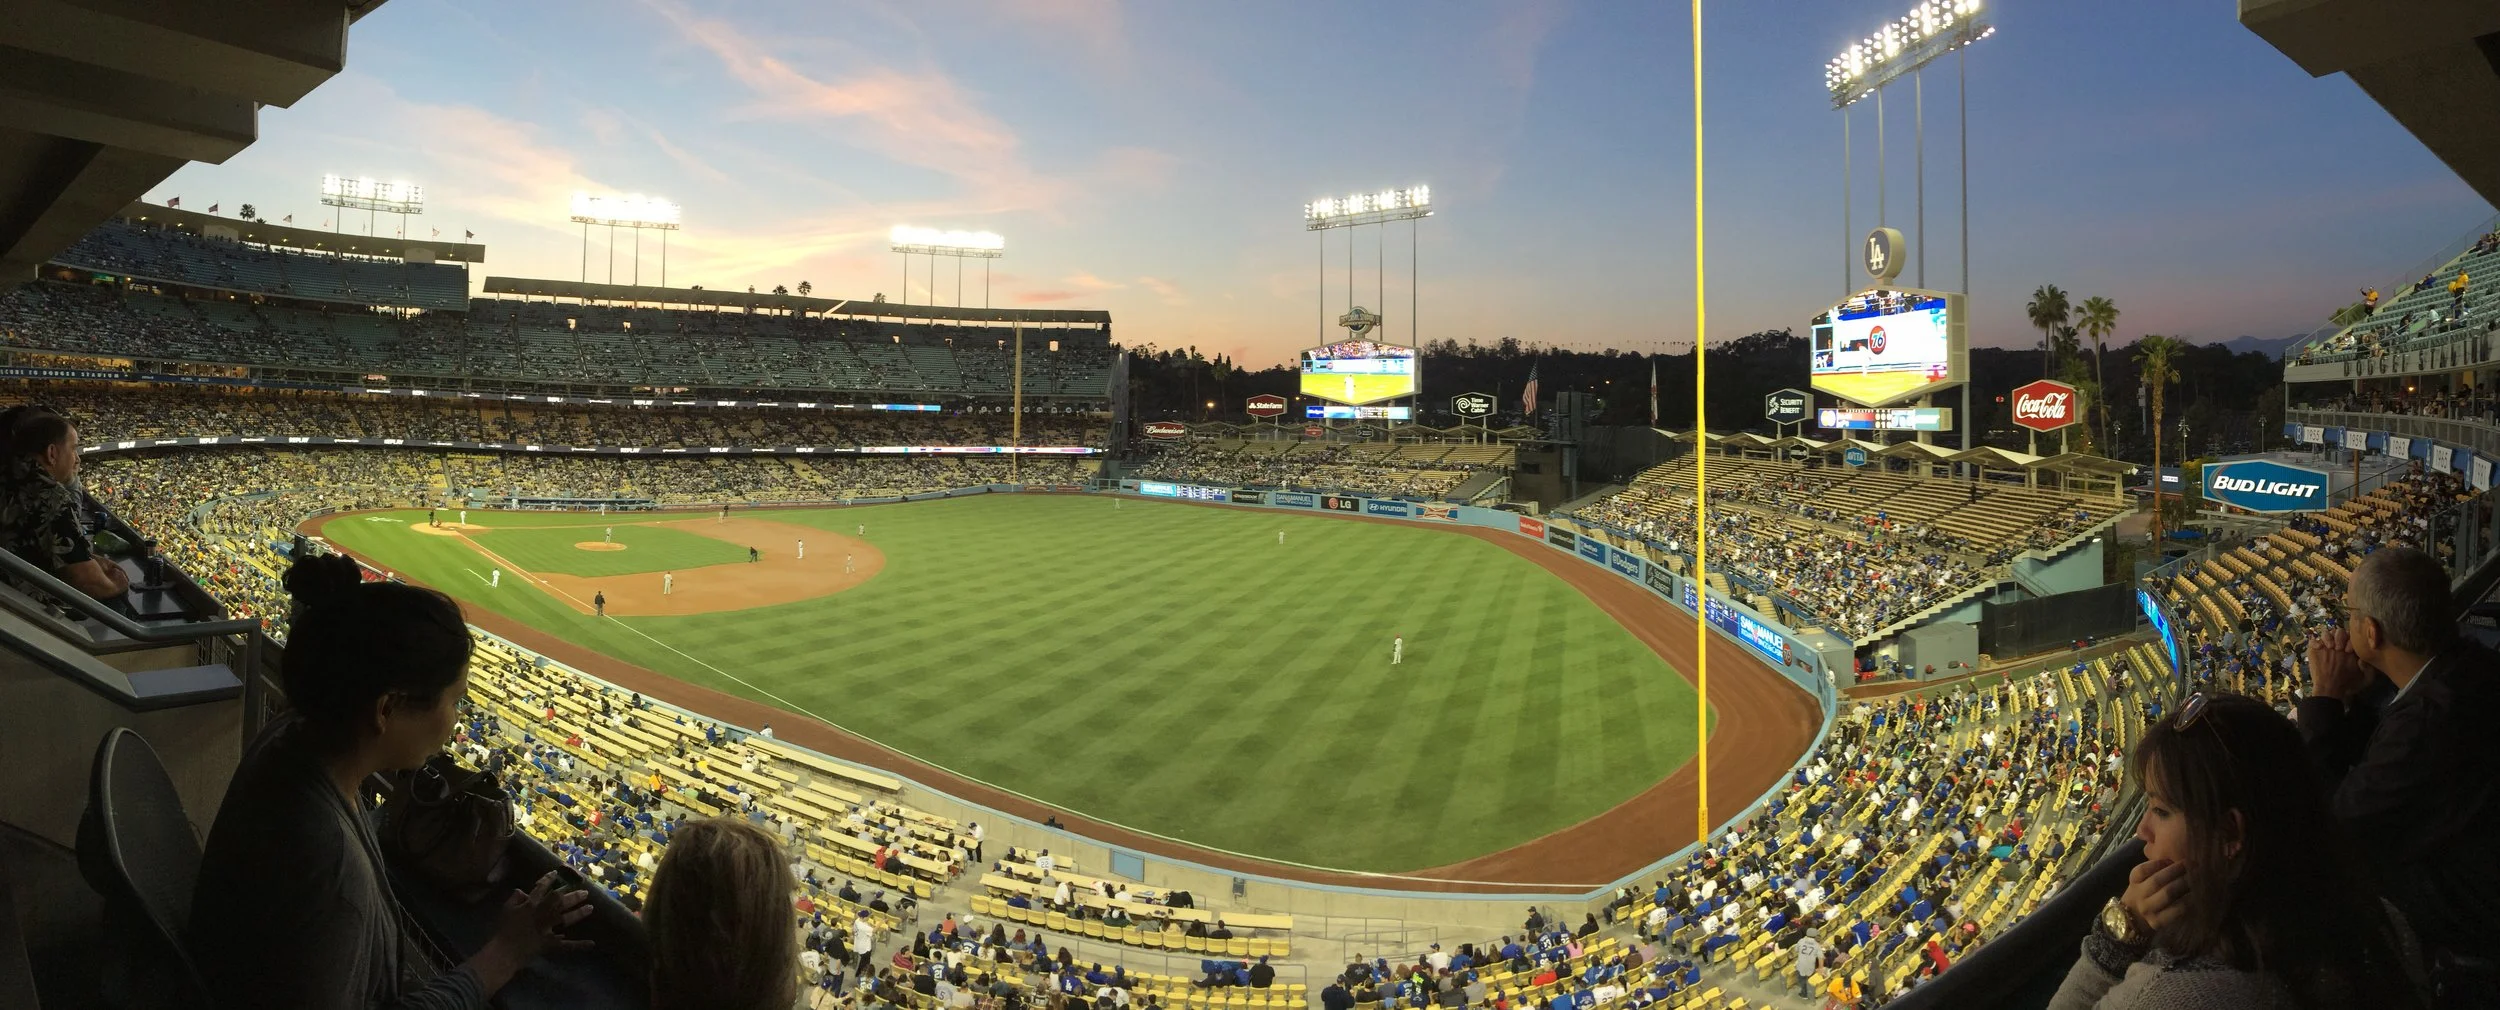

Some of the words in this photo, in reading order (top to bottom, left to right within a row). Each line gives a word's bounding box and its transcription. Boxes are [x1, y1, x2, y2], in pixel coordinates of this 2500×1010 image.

[1870, 238, 1884, 270] LA
[1871, 331, 1884, 348] 76
[2213, 475, 2256, 492] BUD
[2255, 479, 2320, 498] LIGHT
[1340, 501, 1352, 509] LG
[1380, 504, 1407, 513] HYUNDAI
[1740, 615, 1754, 632] SAN
[1757, 625, 1783, 650] MANUEL
[1801, 944, 1814, 956] 27
